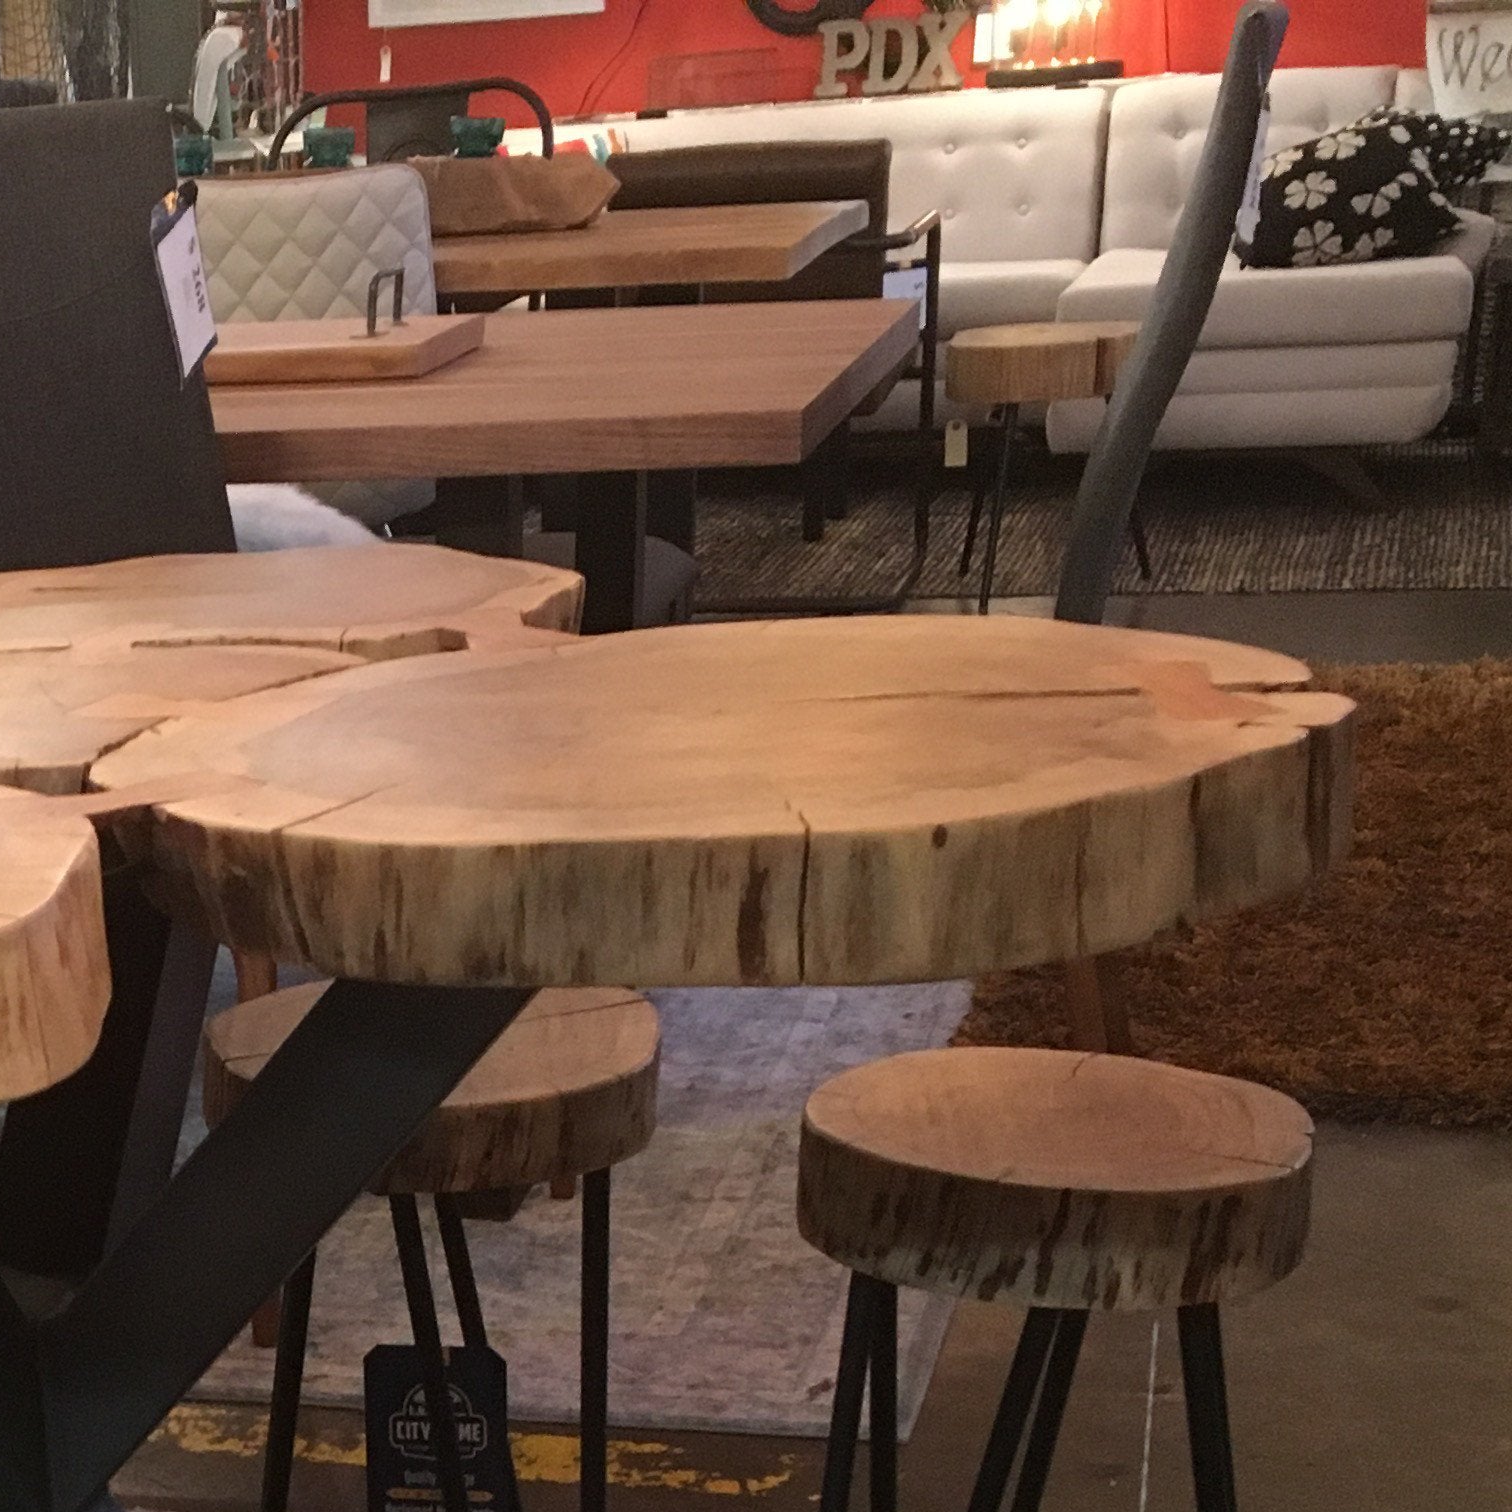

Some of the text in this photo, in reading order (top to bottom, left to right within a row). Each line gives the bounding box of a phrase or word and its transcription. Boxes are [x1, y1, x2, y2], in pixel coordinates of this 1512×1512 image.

[814, 10, 971, 96] PDX
[1439, 25, 1512, 91] We
[396, 1420, 431, 1441] CITY
